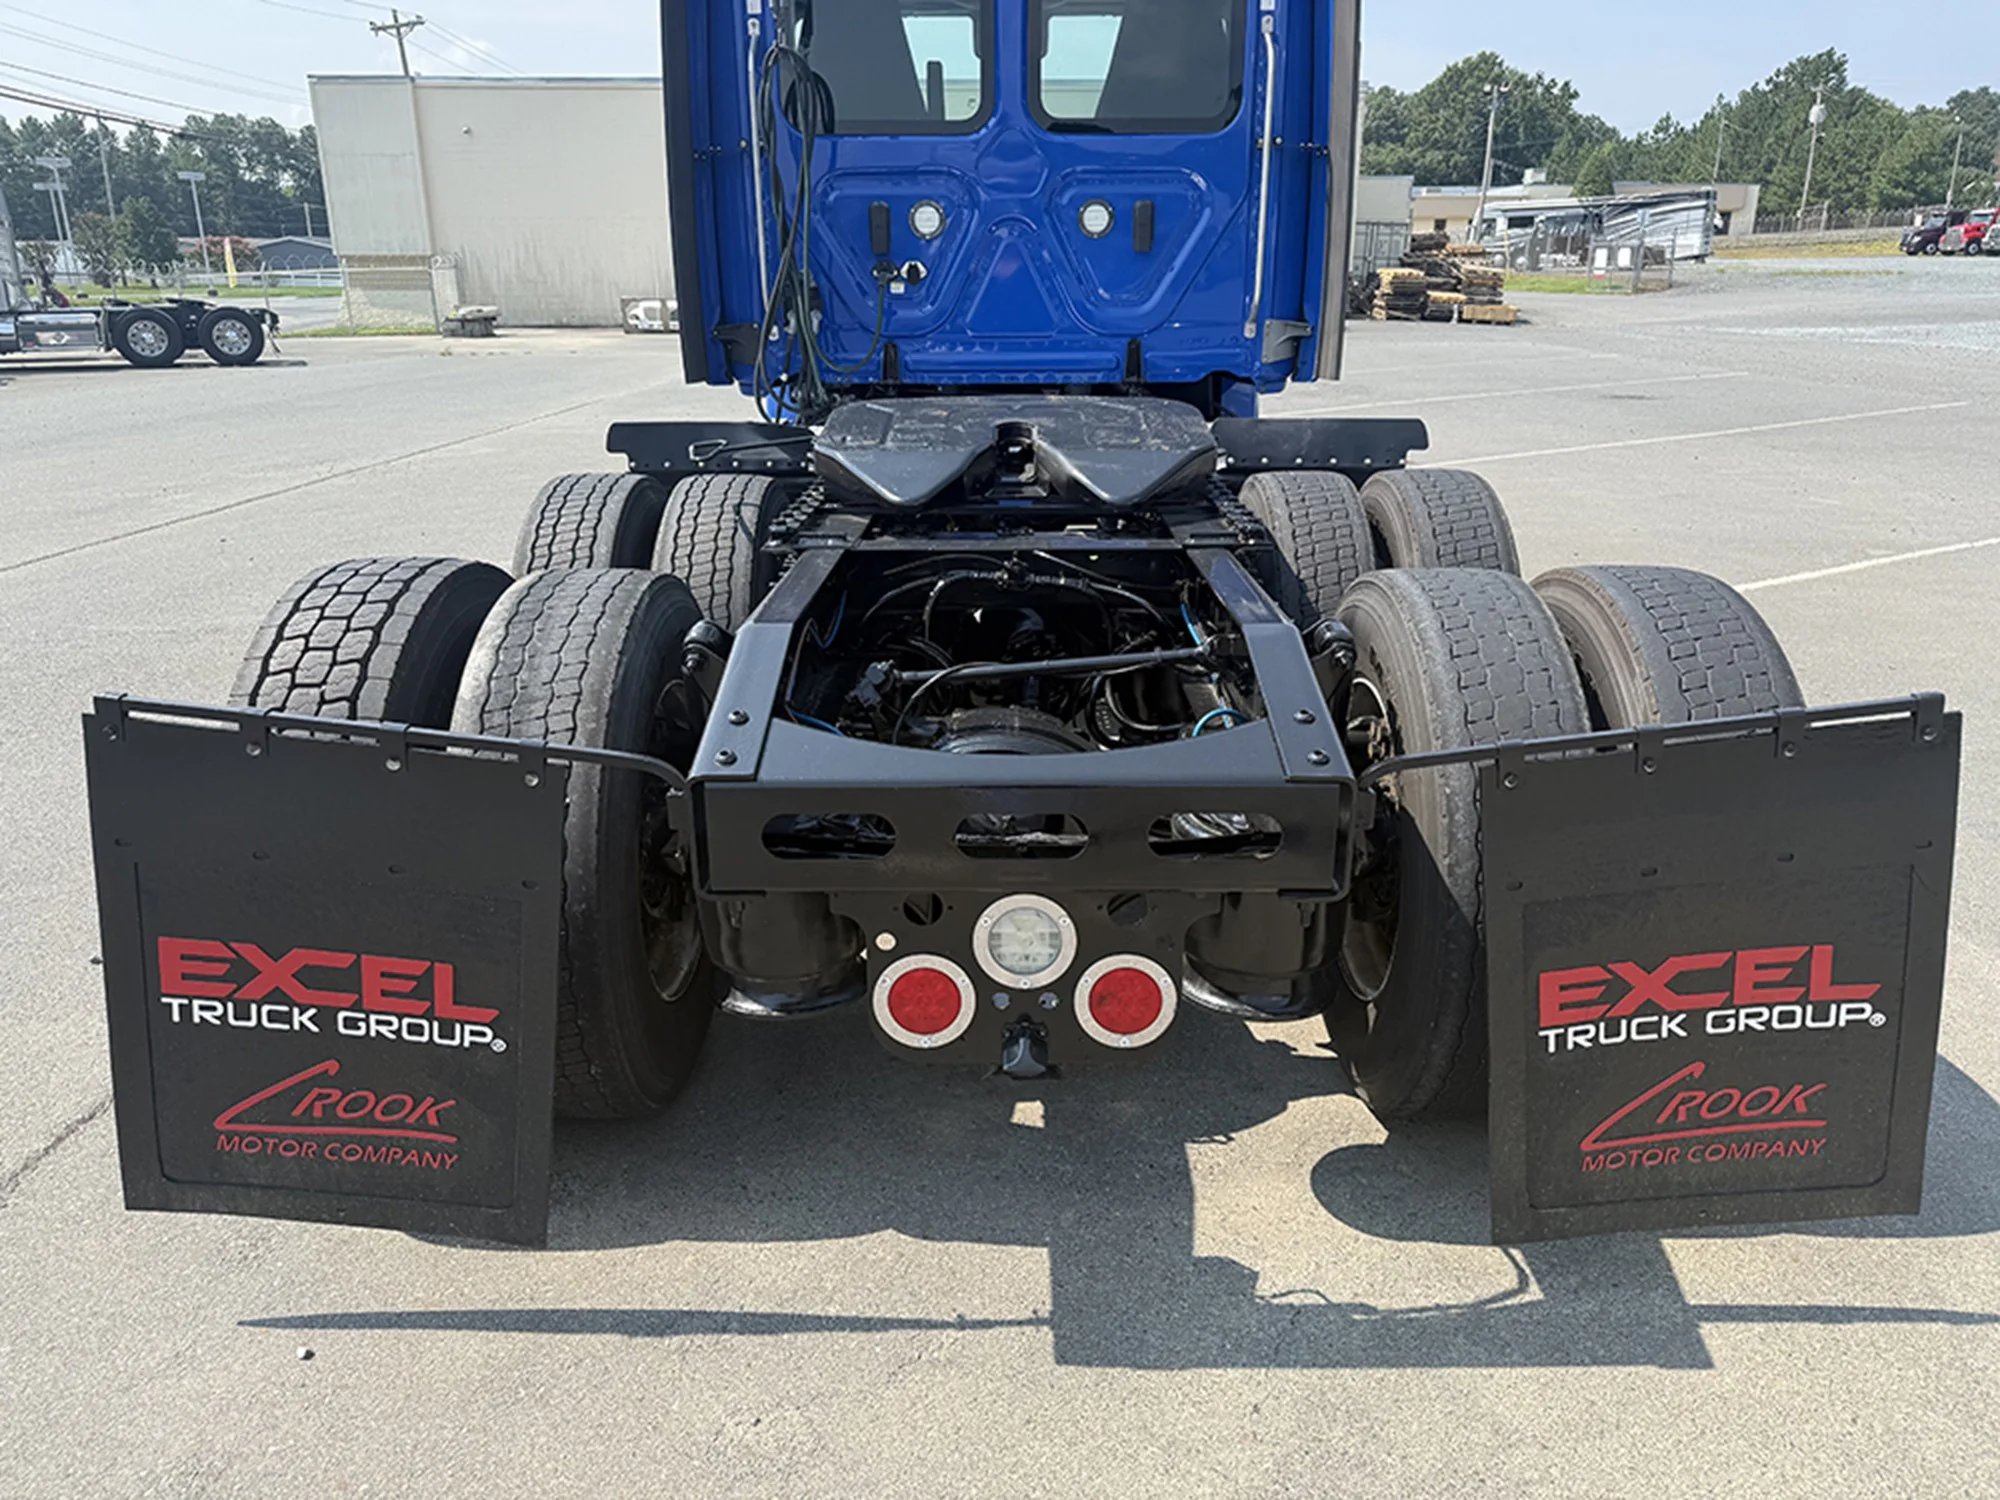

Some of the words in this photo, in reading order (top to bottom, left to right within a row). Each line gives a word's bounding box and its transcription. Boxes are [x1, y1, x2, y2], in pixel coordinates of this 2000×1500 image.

[157, 936, 500, 1023] EXCEL
[1538, 944, 1882, 1029] EXCEL
[160, 996, 320, 1034] TRUCK
[1538, 1012, 1688, 1054] TRUCK
[216, 1134, 317, 1161] MOTOR
[324, 1142, 459, 1171] COMPANY
[1581, 1148, 1680, 1173] MOTOR
[1686, 1138, 1828, 1164] COMPANY
